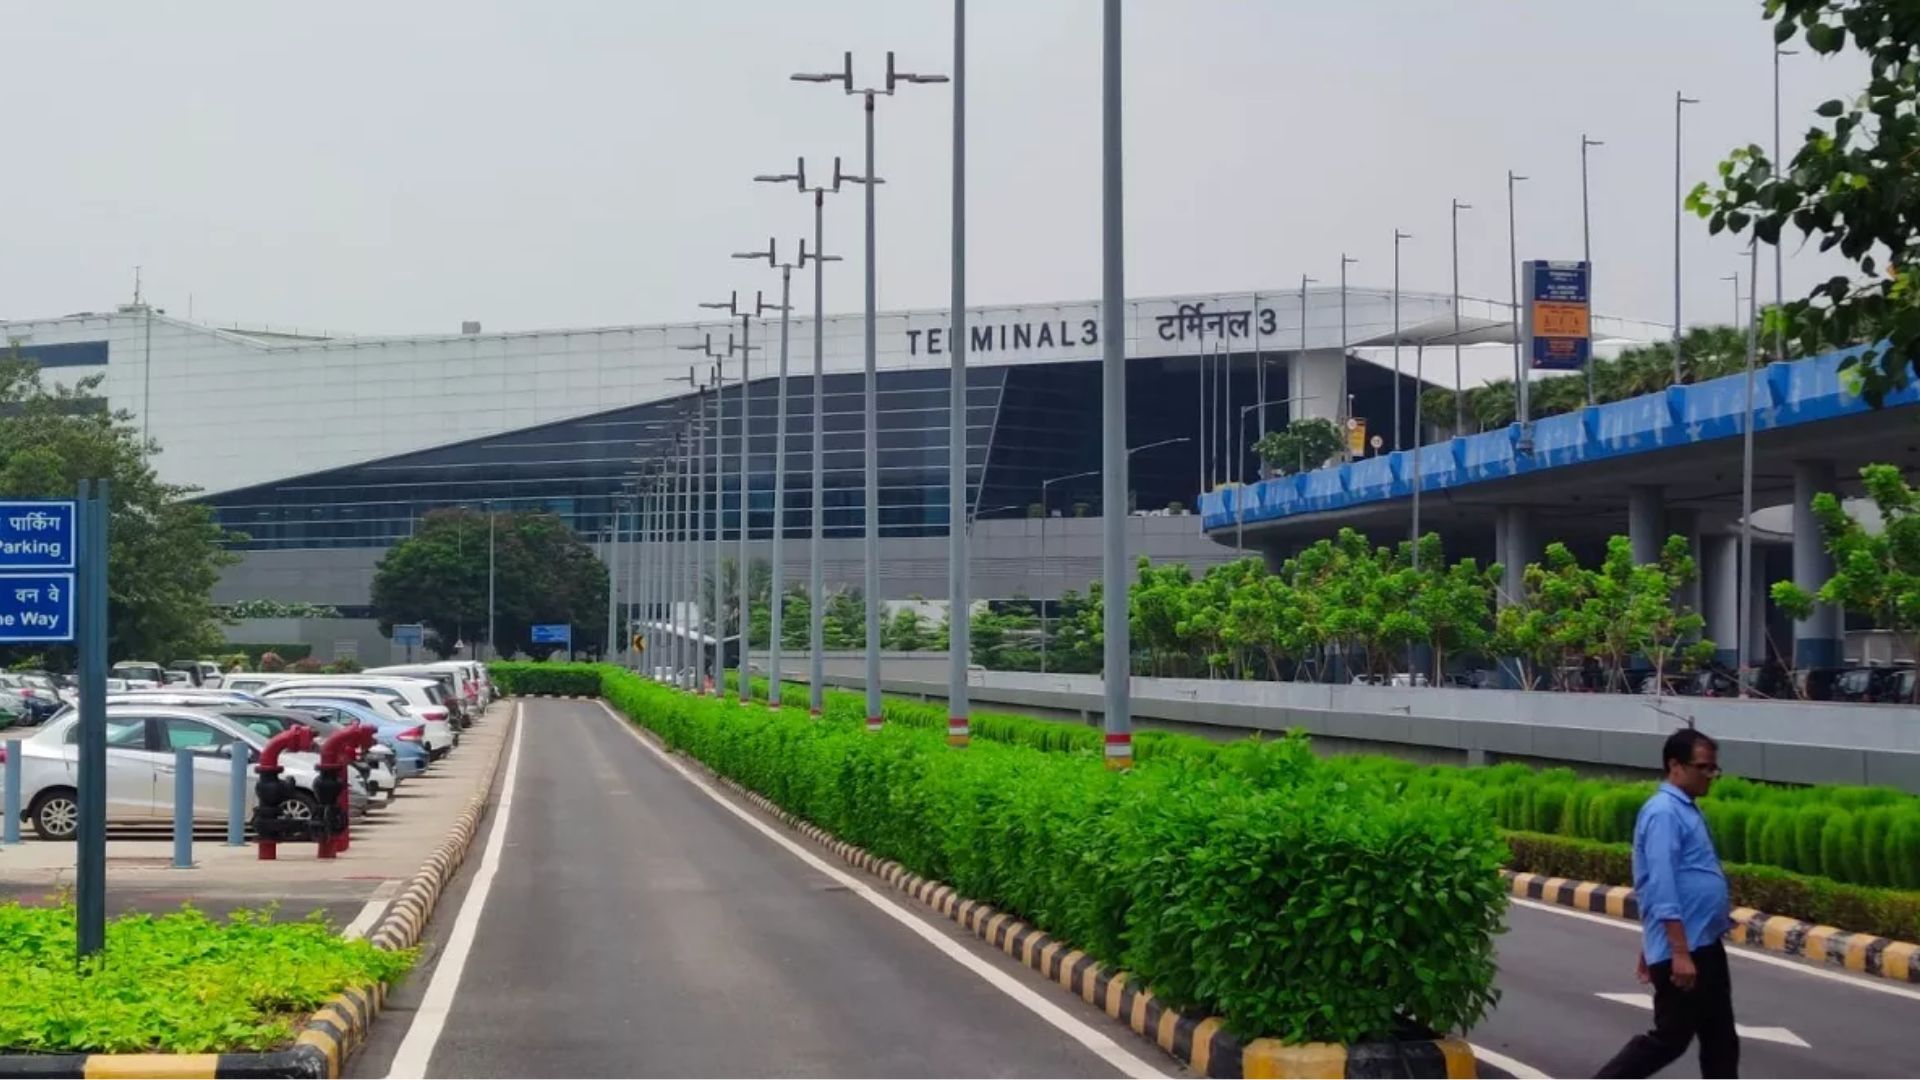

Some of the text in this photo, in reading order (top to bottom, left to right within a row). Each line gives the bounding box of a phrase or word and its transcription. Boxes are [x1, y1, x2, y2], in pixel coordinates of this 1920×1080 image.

[1155, 302, 1277, 341] टर्मिनल 3
[0, 539, 61, 557] arking
[14, 583, 60, 603] वन वे
[20, 611, 59, 630] Way
